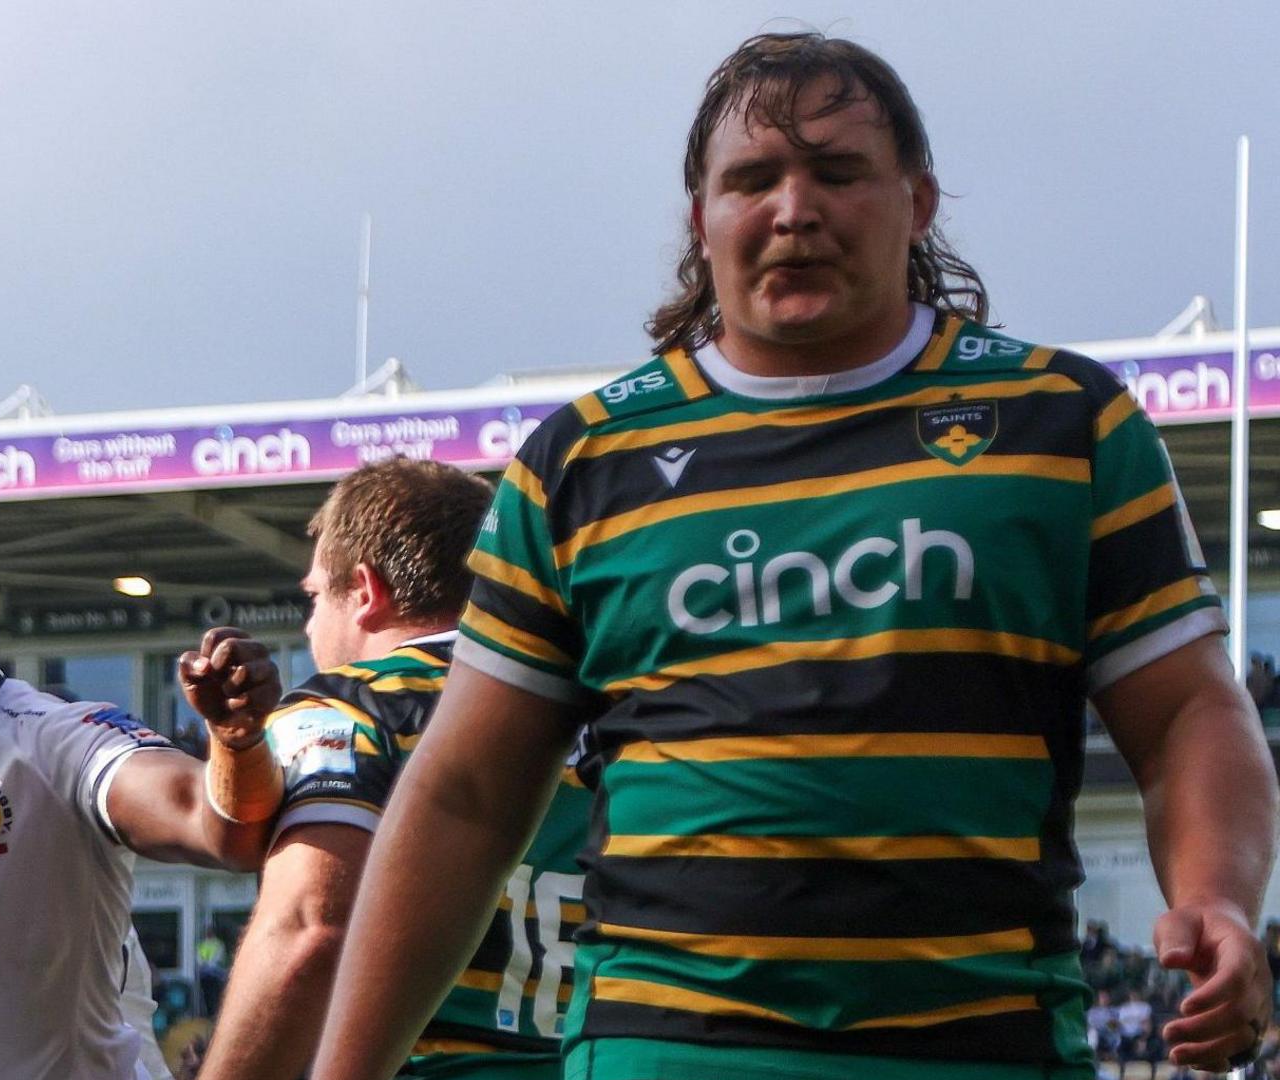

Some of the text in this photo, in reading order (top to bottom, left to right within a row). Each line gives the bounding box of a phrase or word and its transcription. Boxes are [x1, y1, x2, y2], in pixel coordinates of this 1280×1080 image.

[959, 336, 1025, 360] grs
[603, 369, 666, 403] grs
[1121, 360, 1230, 412] inch
[477, 406, 541, 458] cin
[931, 412, 983, 424] SAINTS
[192, 425, 310, 475] cinch
[668, 517, 974, 635] cinch
